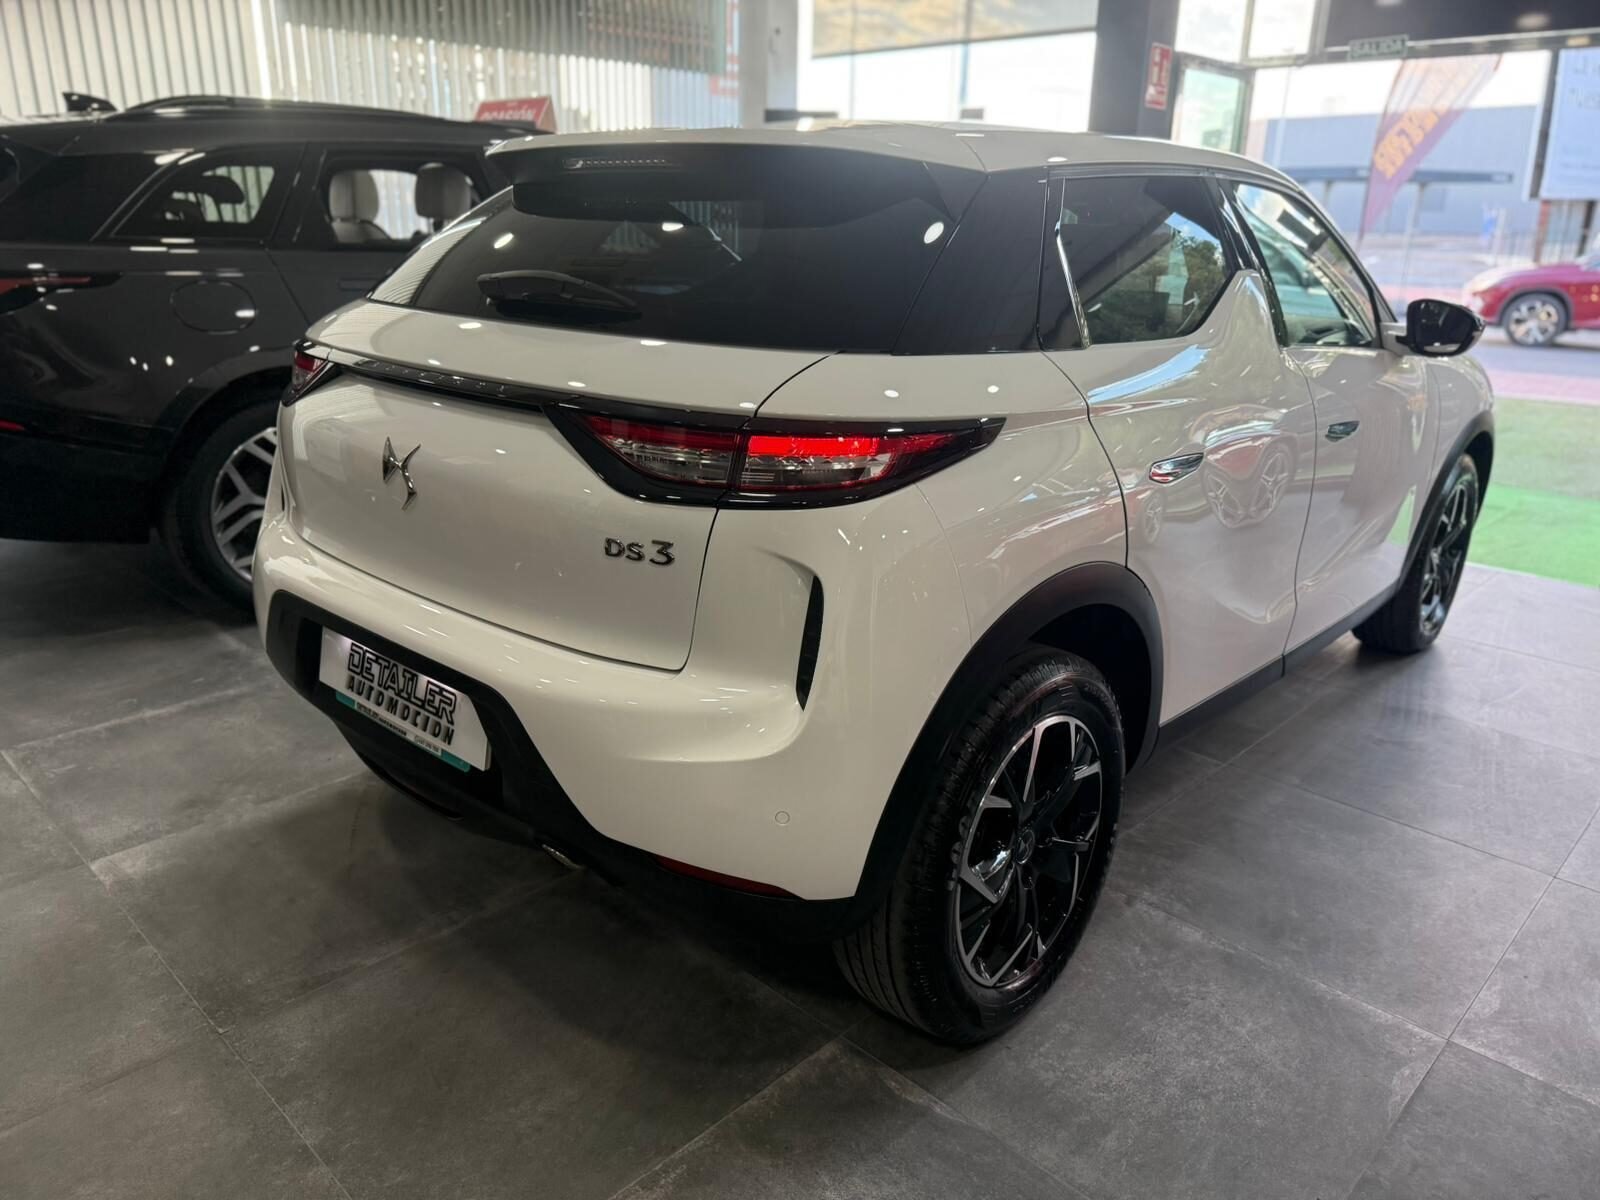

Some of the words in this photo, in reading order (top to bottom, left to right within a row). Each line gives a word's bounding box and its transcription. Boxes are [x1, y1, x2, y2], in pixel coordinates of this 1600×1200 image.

[605, 538, 645, 561] DS
[649, 540, 675, 566] 3
[348, 642, 457, 726] DETAILER
